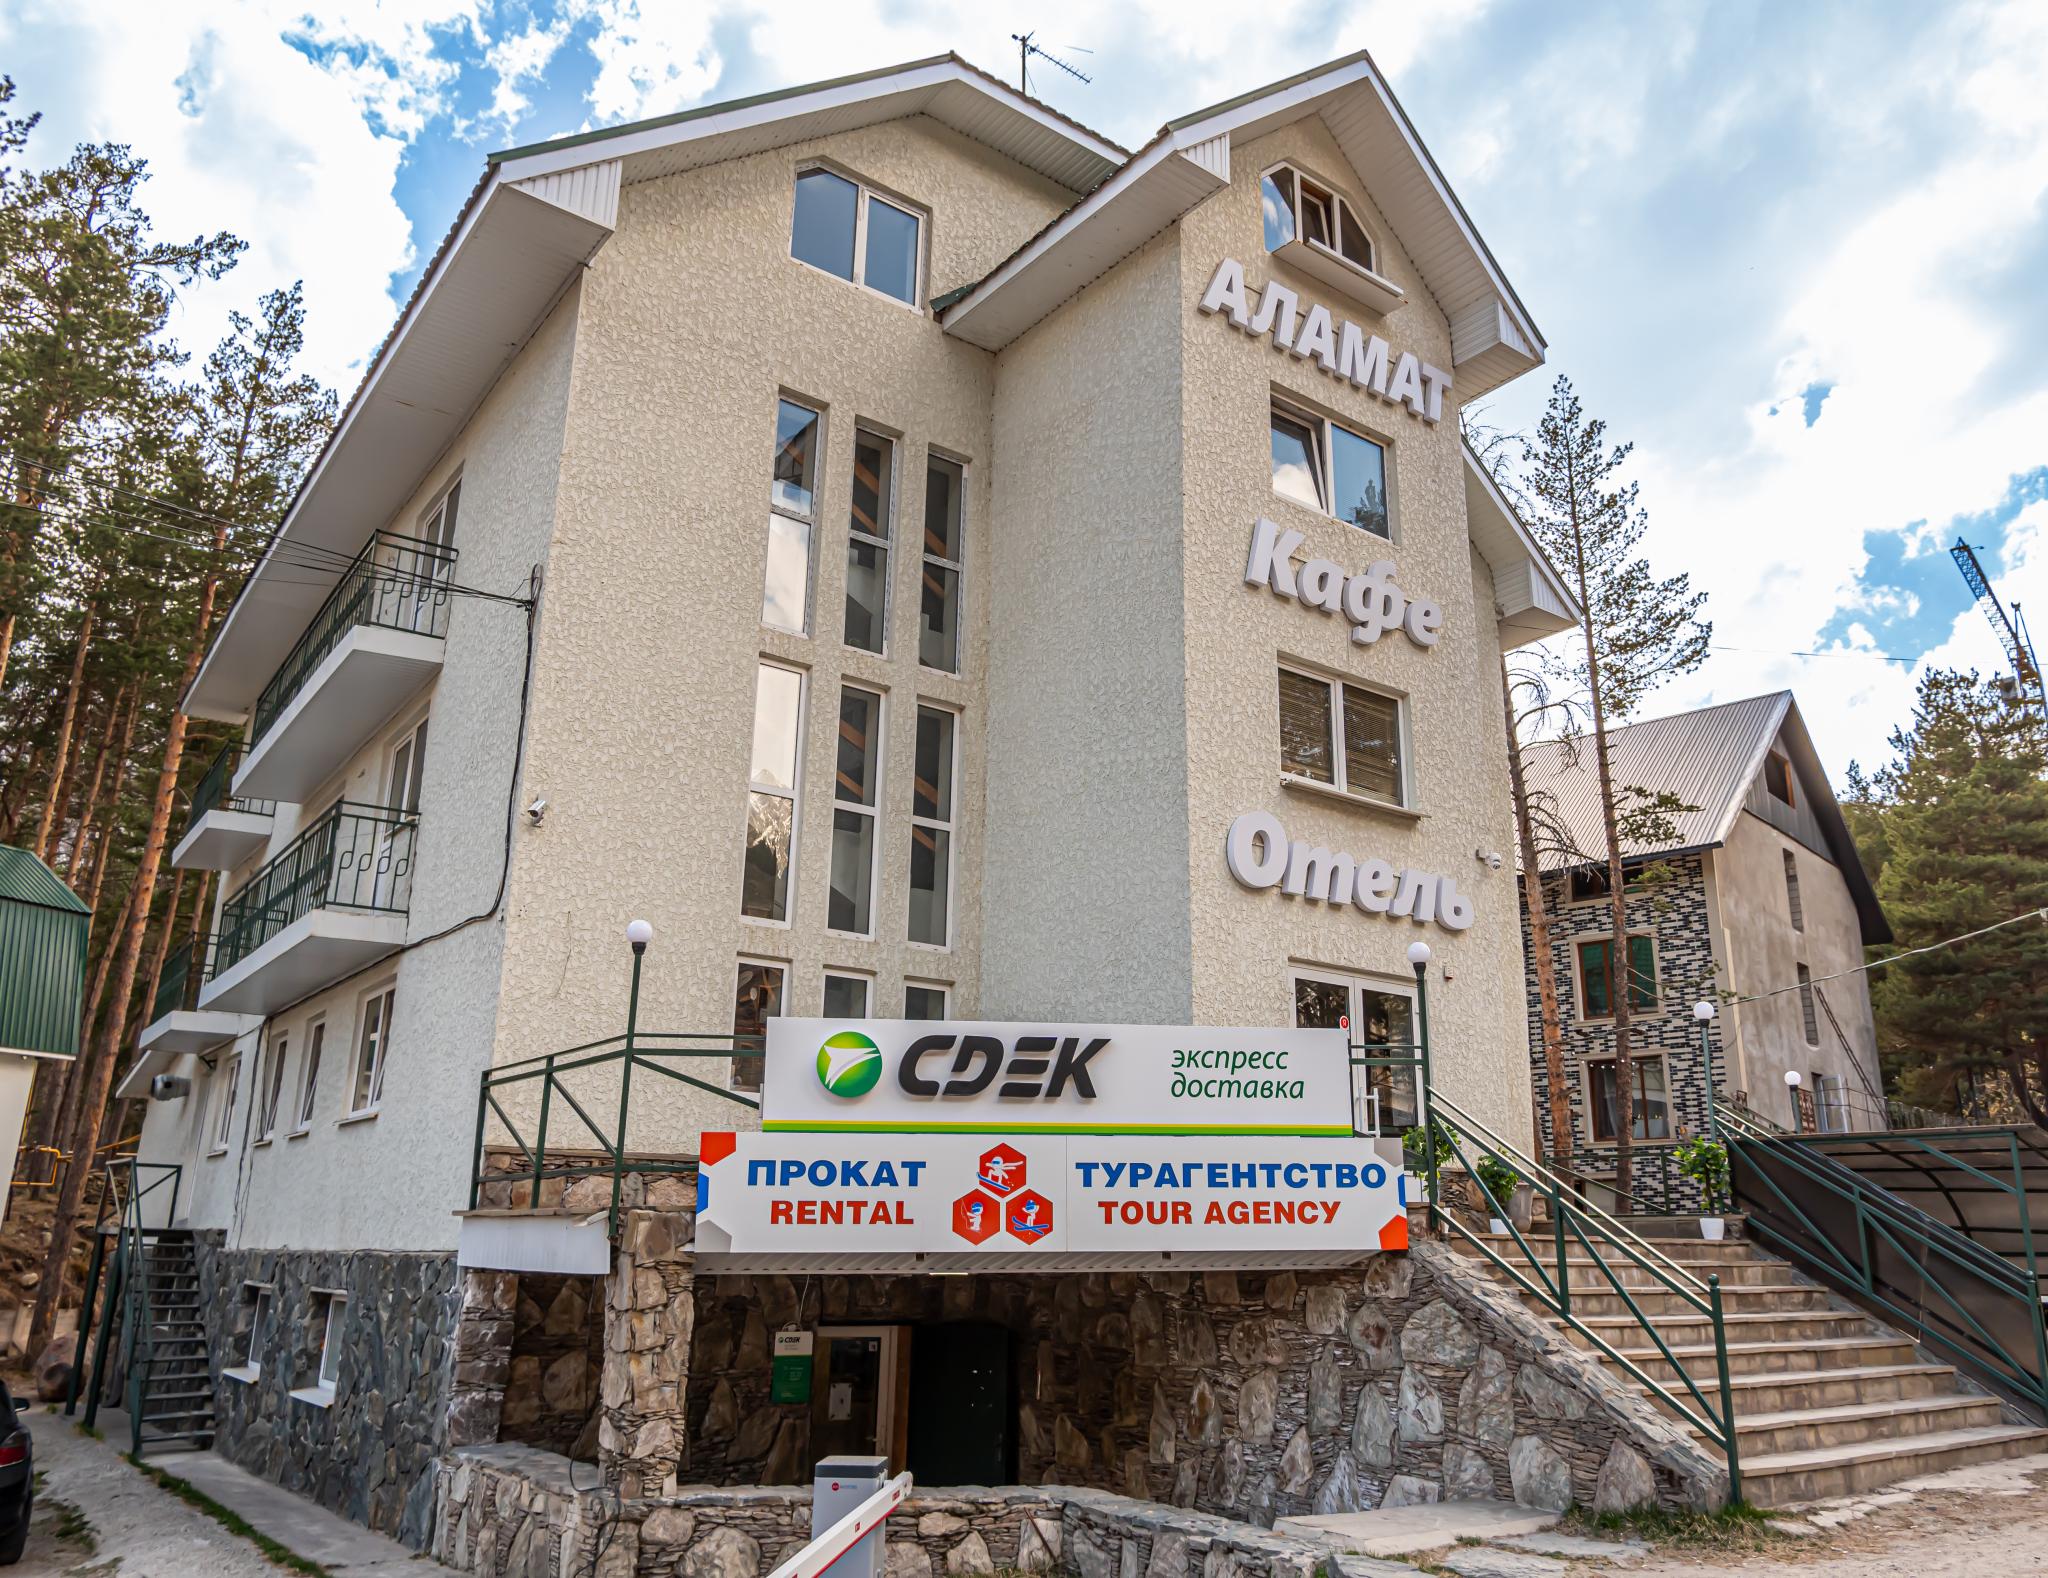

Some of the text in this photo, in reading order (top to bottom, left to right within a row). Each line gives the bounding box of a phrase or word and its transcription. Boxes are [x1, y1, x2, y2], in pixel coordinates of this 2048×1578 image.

[1199, 258, 1452, 424] АЛАМАТ
[1245, 518, 1442, 647] Кафе
[1227, 812, 1474, 931] Отель
[898, 1035, 1111, 1098] CDEK
[1171, 1049, 1289, 1075] экспресс
[1170, 1073, 1305, 1099] доставка
[747, 1160, 927, 1188] ПРОКАТ
[1075, 1162, 1387, 1189] ТУРАГЕНТСТВО
[770, 1200, 914, 1225] RENTAL
[1098, 1201, 1341, 1225] TOUR AGENCY
